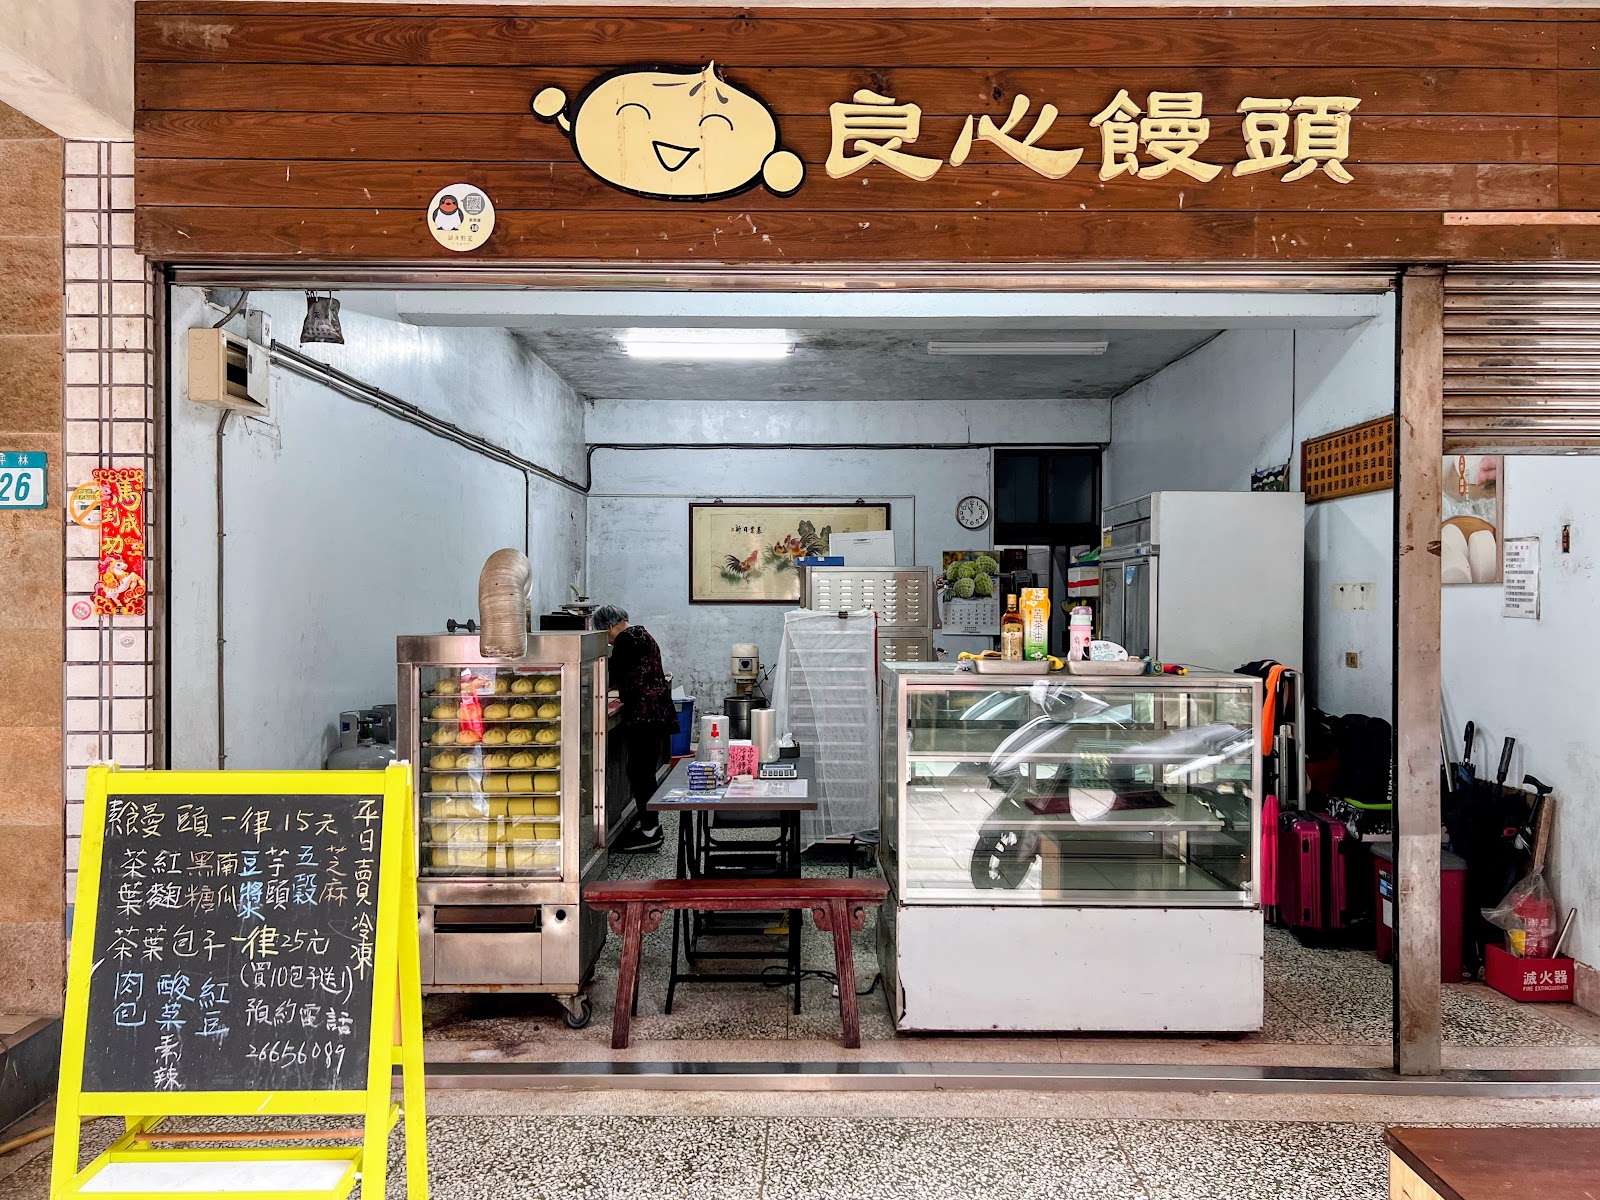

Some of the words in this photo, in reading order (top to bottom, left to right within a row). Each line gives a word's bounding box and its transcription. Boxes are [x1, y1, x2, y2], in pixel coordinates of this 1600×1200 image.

[825, 89, 1362, 184] 良心饅頭
[0, 472, 31, 501] 26
[101, 480, 142, 555] 馬到成功
[1033, 609, 1044, 643] 苦茶油
[113, 972, 146, 1028] 肉包
[1523, 970, 1568, 985] 滅火器
[195, 977, 230, 1038] 紅豆
[244, 998, 354, 1036] 預約電話
